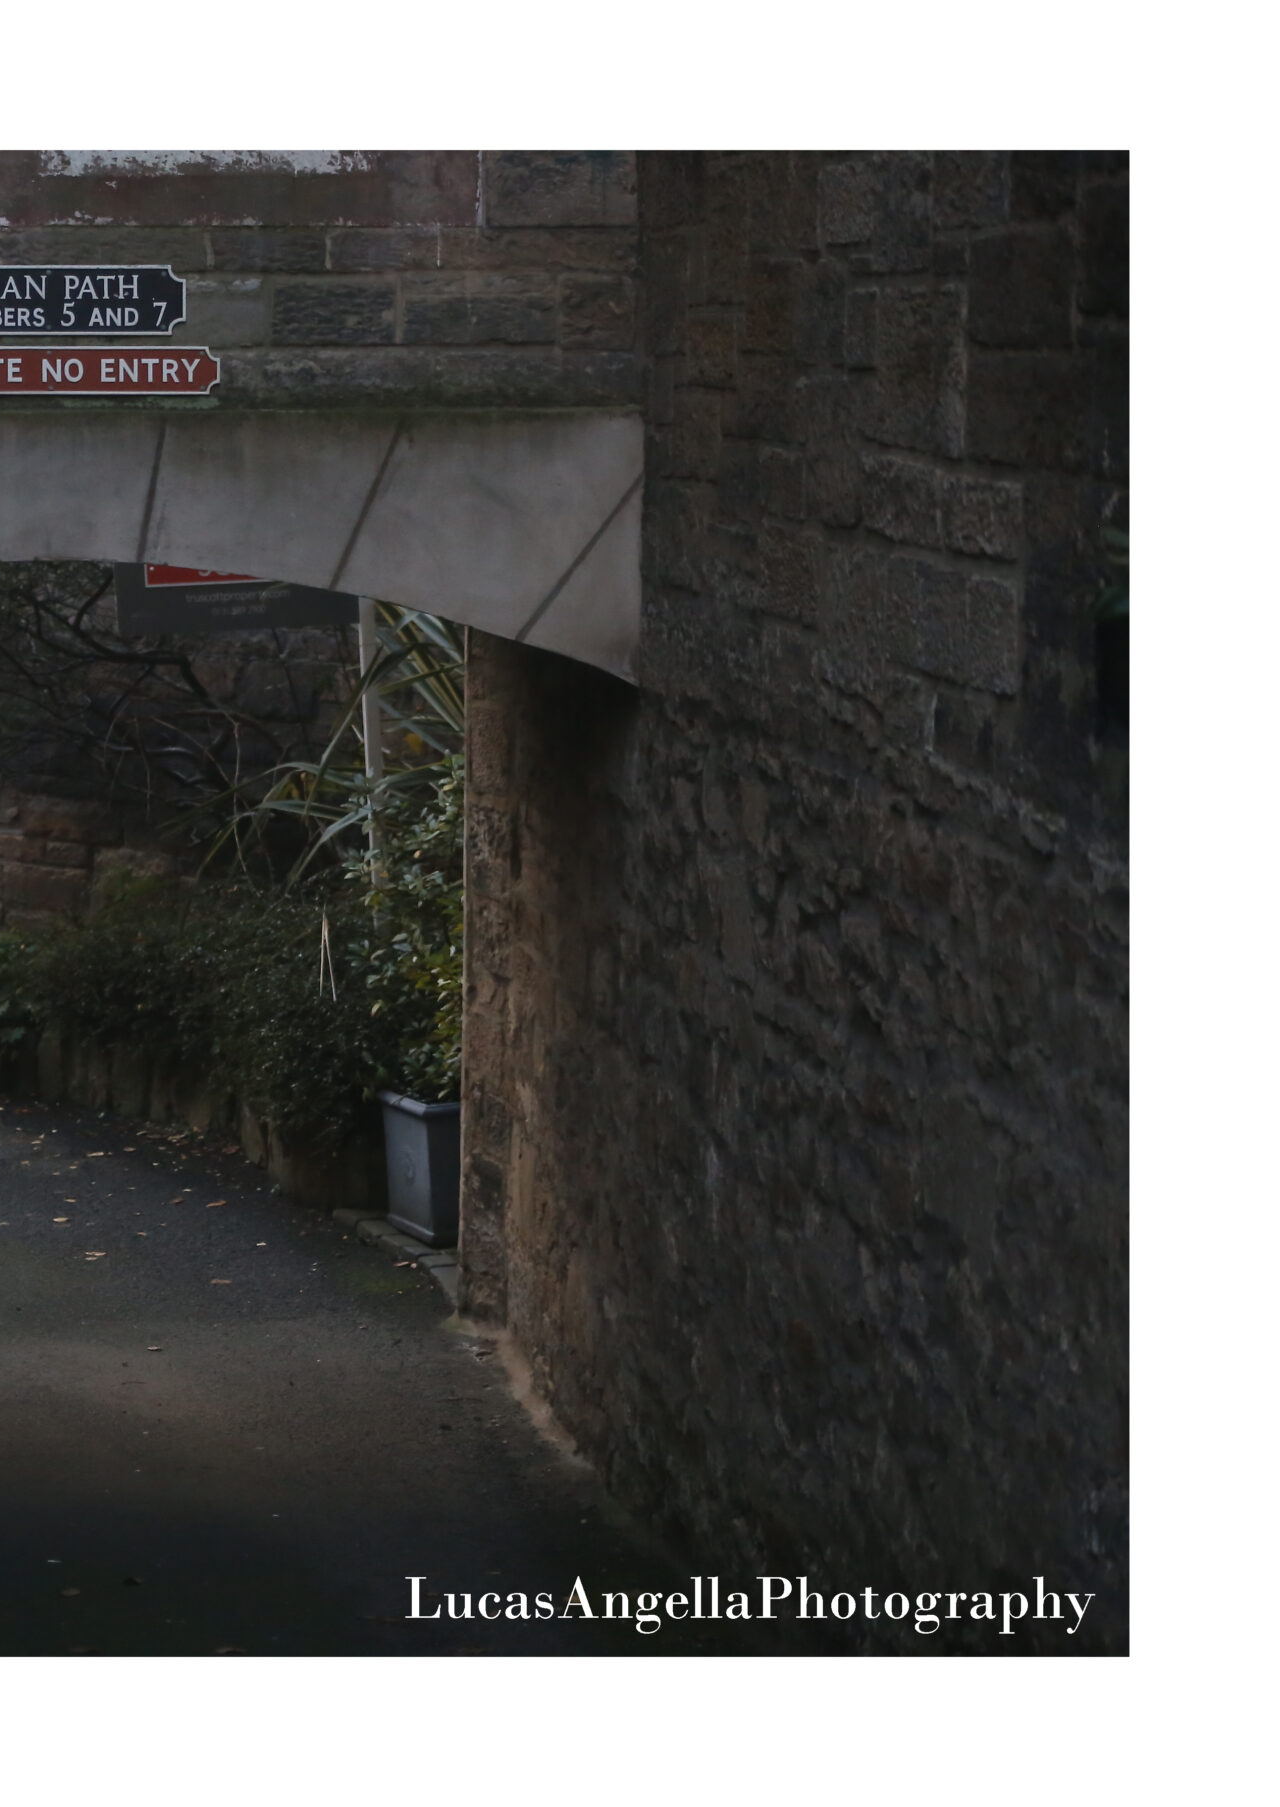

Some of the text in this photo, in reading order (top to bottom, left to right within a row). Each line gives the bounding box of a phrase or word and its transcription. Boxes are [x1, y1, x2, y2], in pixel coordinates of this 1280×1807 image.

[64, 275, 140, 300] PATH
[60, 302, 76, 327] 5
[88, 307, 139, 327] AND
[152, 301, 170, 327] 7
[42, 358, 84, 383] NO
[100, 358, 201, 383] ENTRY
